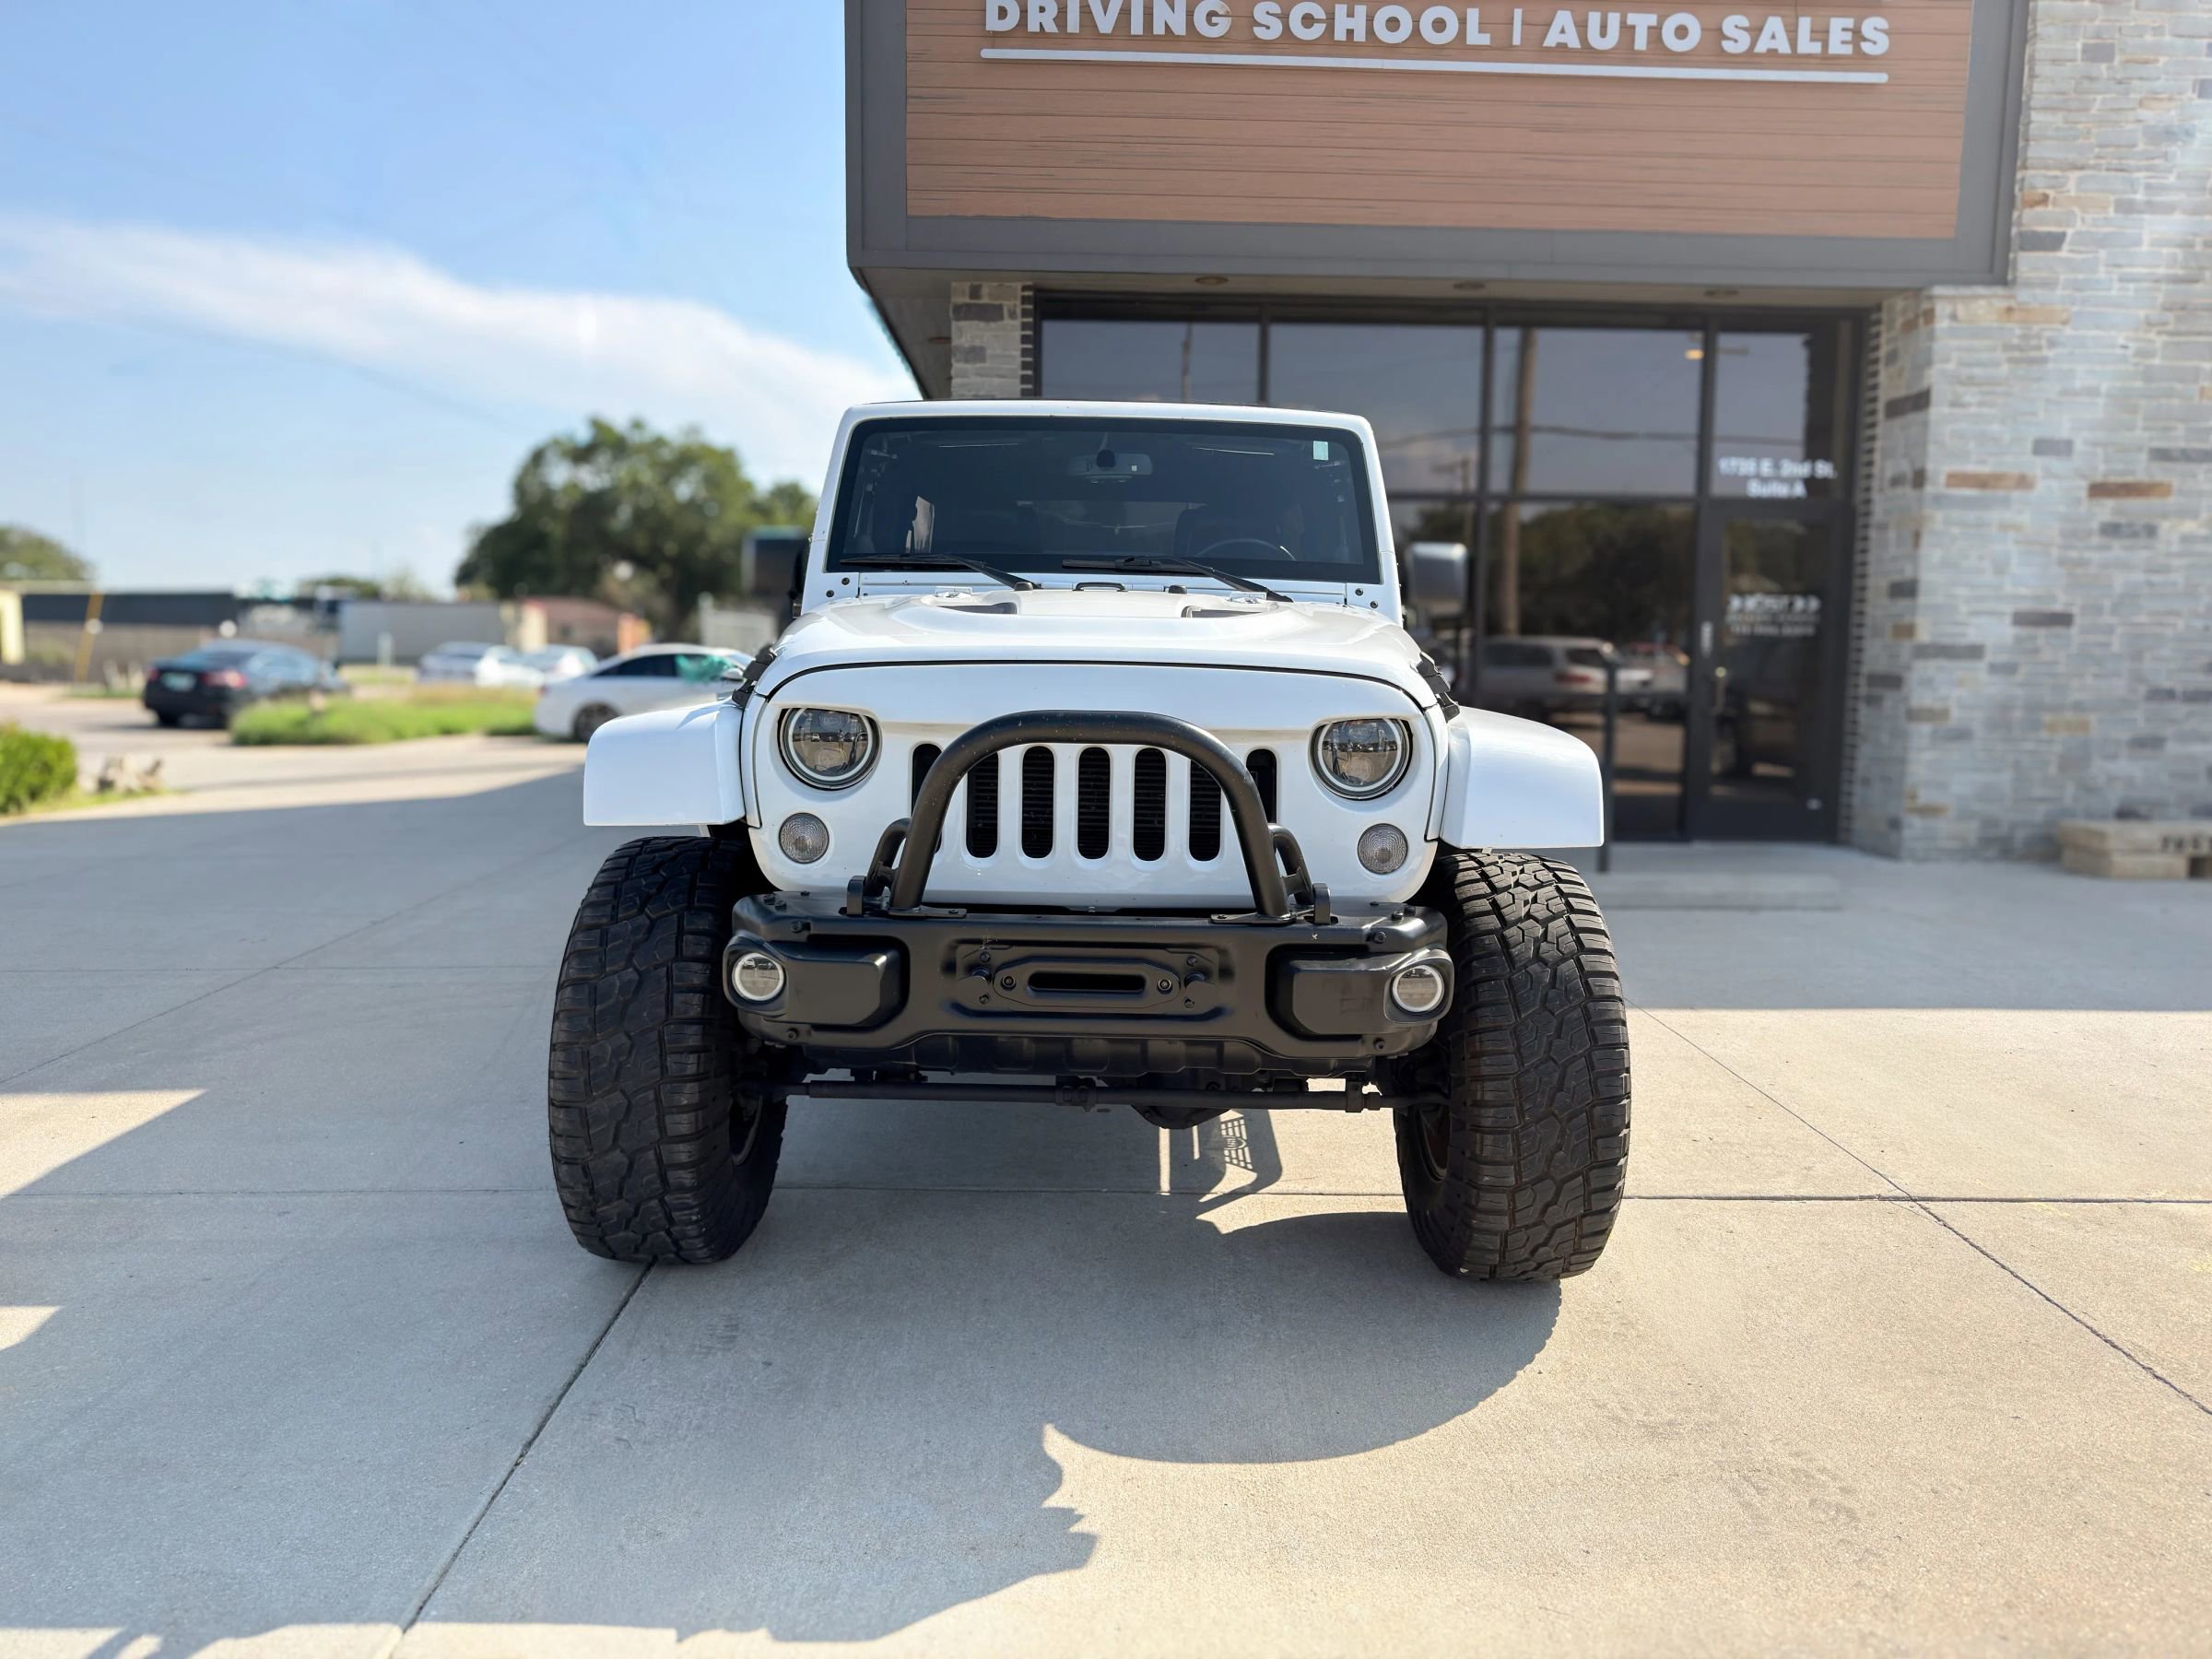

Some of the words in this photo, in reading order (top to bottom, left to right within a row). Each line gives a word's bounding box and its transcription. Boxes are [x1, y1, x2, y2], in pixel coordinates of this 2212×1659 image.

[985, 0, 1231, 38] DRIVING
[1253, 2, 1491, 45] SCHOOL
[1542, 10, 1701, 53] AUTO
[1721, 15, 1889, 55] SALES
[1780, 458, 1812, 478] 2nd
